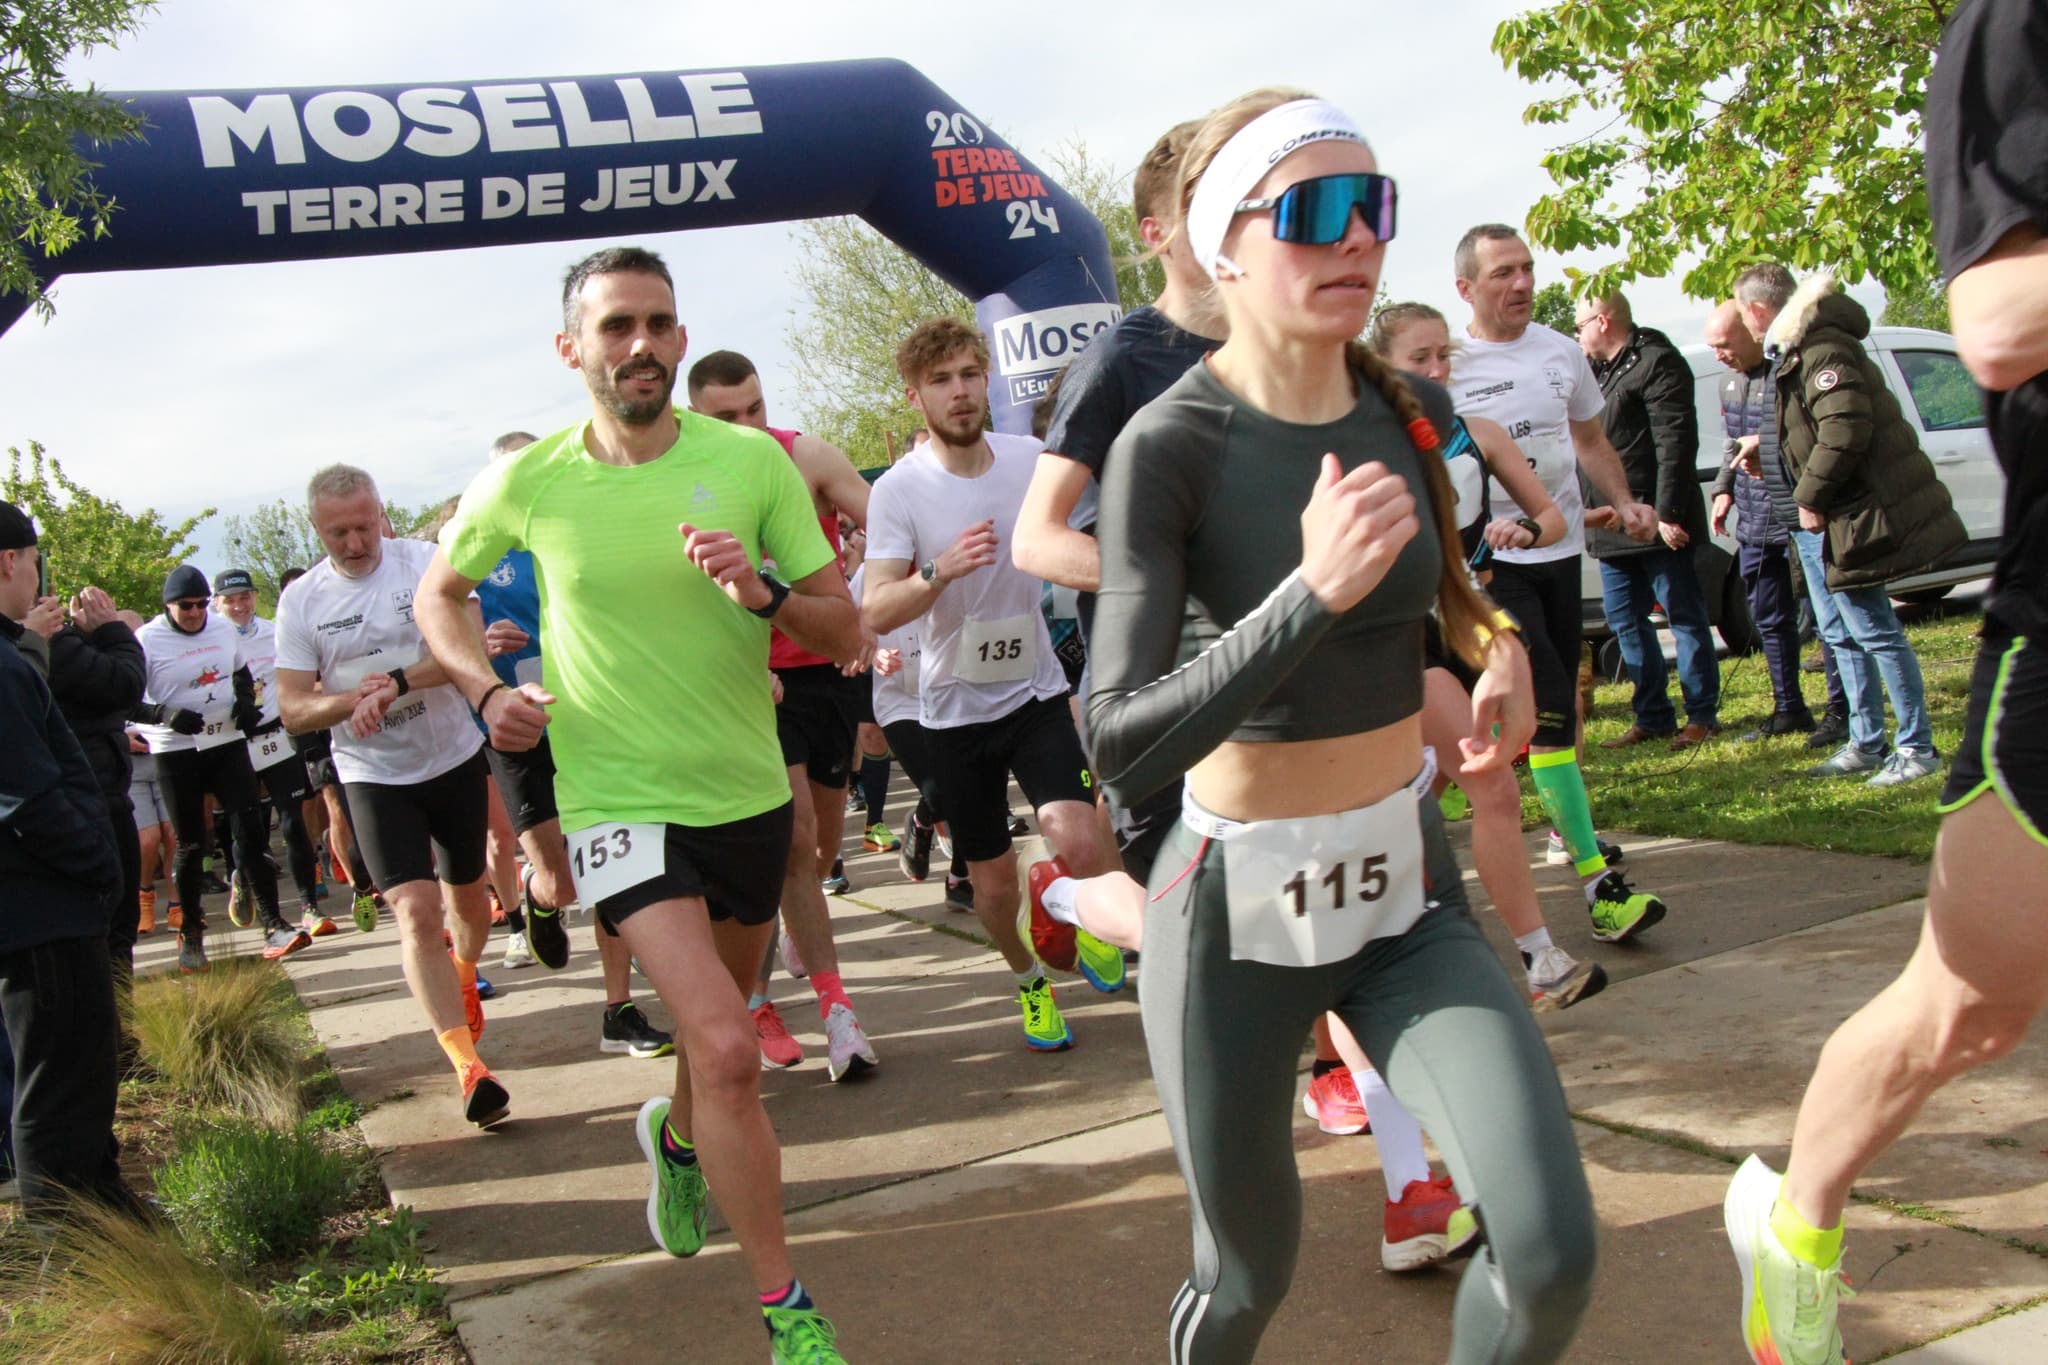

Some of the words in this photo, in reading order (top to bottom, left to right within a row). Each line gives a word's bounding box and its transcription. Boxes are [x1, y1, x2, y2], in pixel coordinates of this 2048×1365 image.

[188, 72, 763, 168] MOSELLE
[926, 110, 984, 147] 20
[932, 147, 1021, 177] TERRE
[241, 180, 465, 235] TERRE
[481, 172, 565, 220] DE
[579, 159, 738, 213] JEUX
[935, 177, 976, 208] DE
[980, 173, 1049, 202] JEUX
[1006, 200, 1060, 240] 24
[1015, 377, 1053, 398] L'Eu
[978, 638, 1022, 663] 135
[207, 722, 223, 735] 87
[262, 741, 278, 756] 88
[574, 828, 632, 879] 153
[1282, 852, 1389, 918] 115
